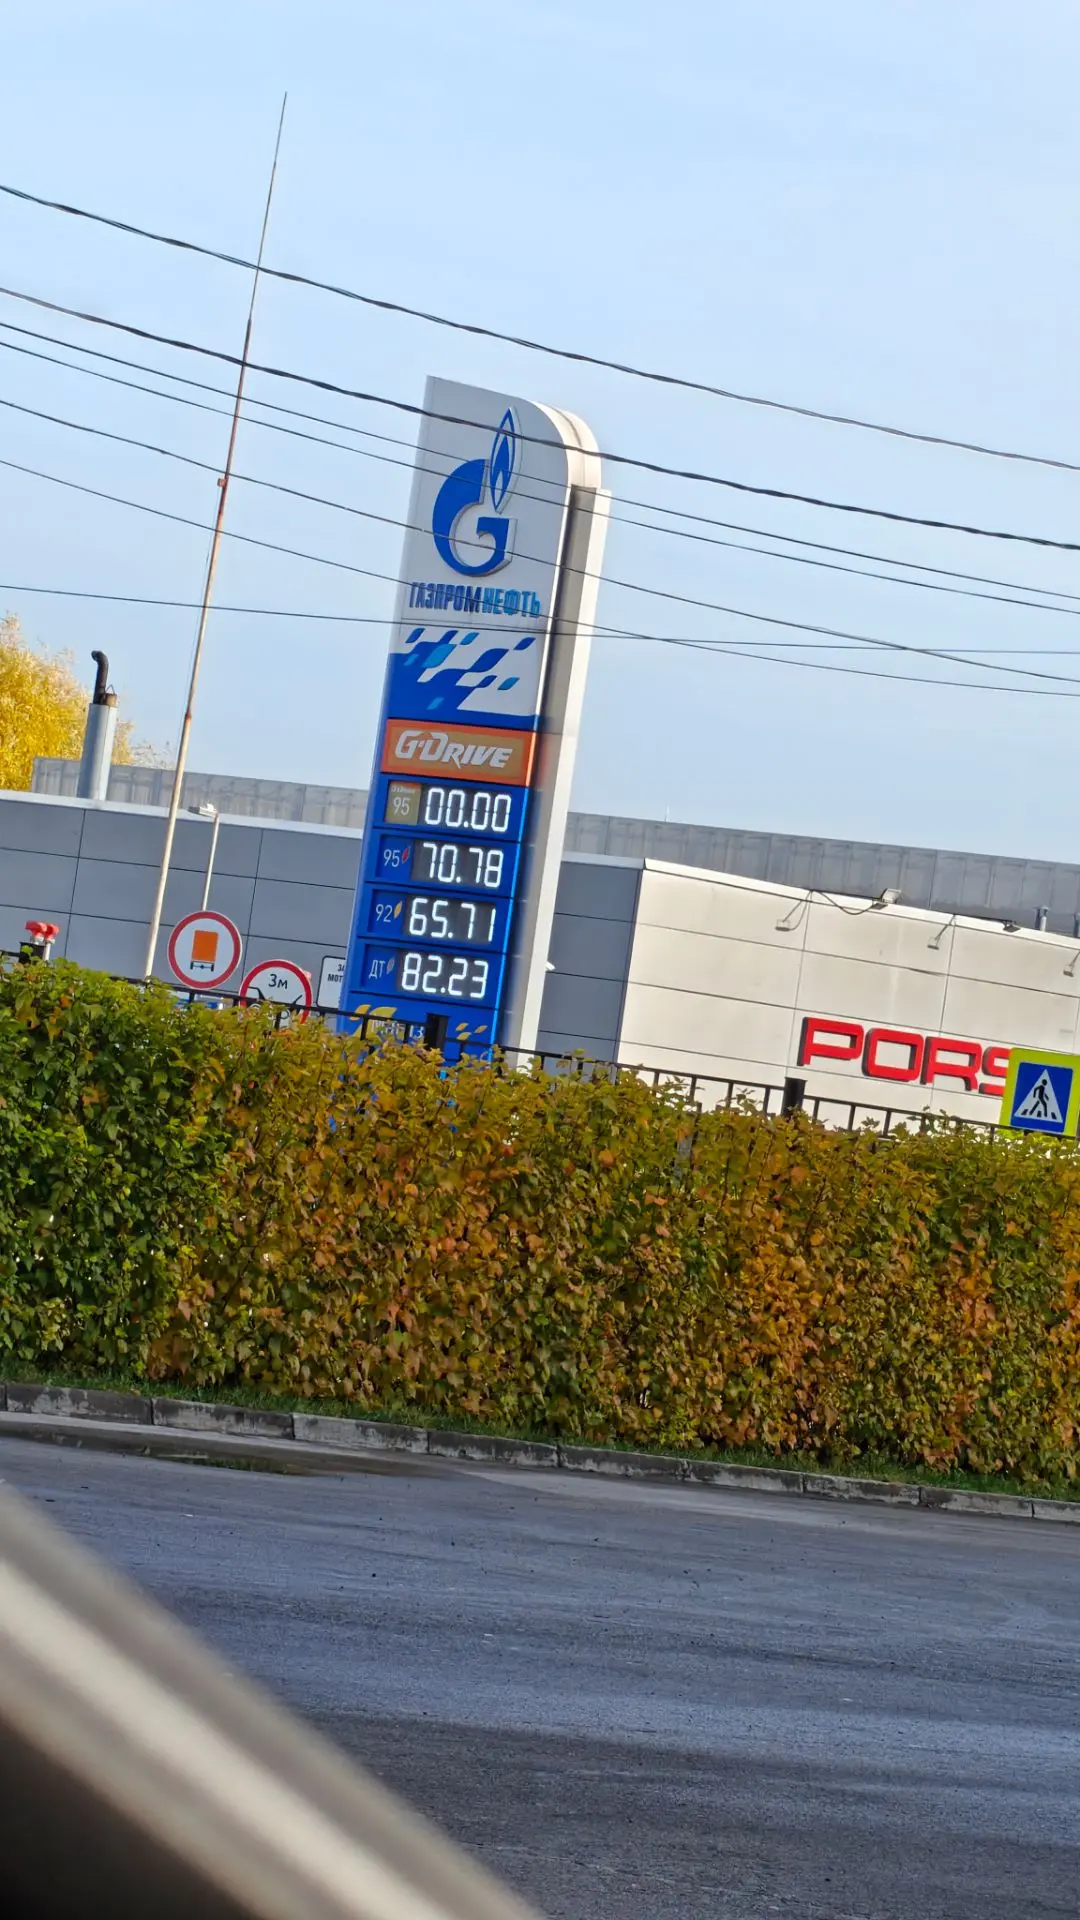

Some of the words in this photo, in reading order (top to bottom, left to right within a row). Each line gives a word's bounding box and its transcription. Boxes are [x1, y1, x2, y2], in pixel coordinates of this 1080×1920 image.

[409, 581, 541, 618] ГАЗПРОМНЕФТЬ
[393, 797, 411, 816] 95
[424, 787, 512, 832] 00.00
[383, 849, 400, 868] 95
[423, 842, 504, 888] 70.78
[375, 903, 392, 923] 92
[408, 897, 497, 942] 65.71
[368, 959, 385, 981] ДТ
[401, 952, 489, 999] 82.23
